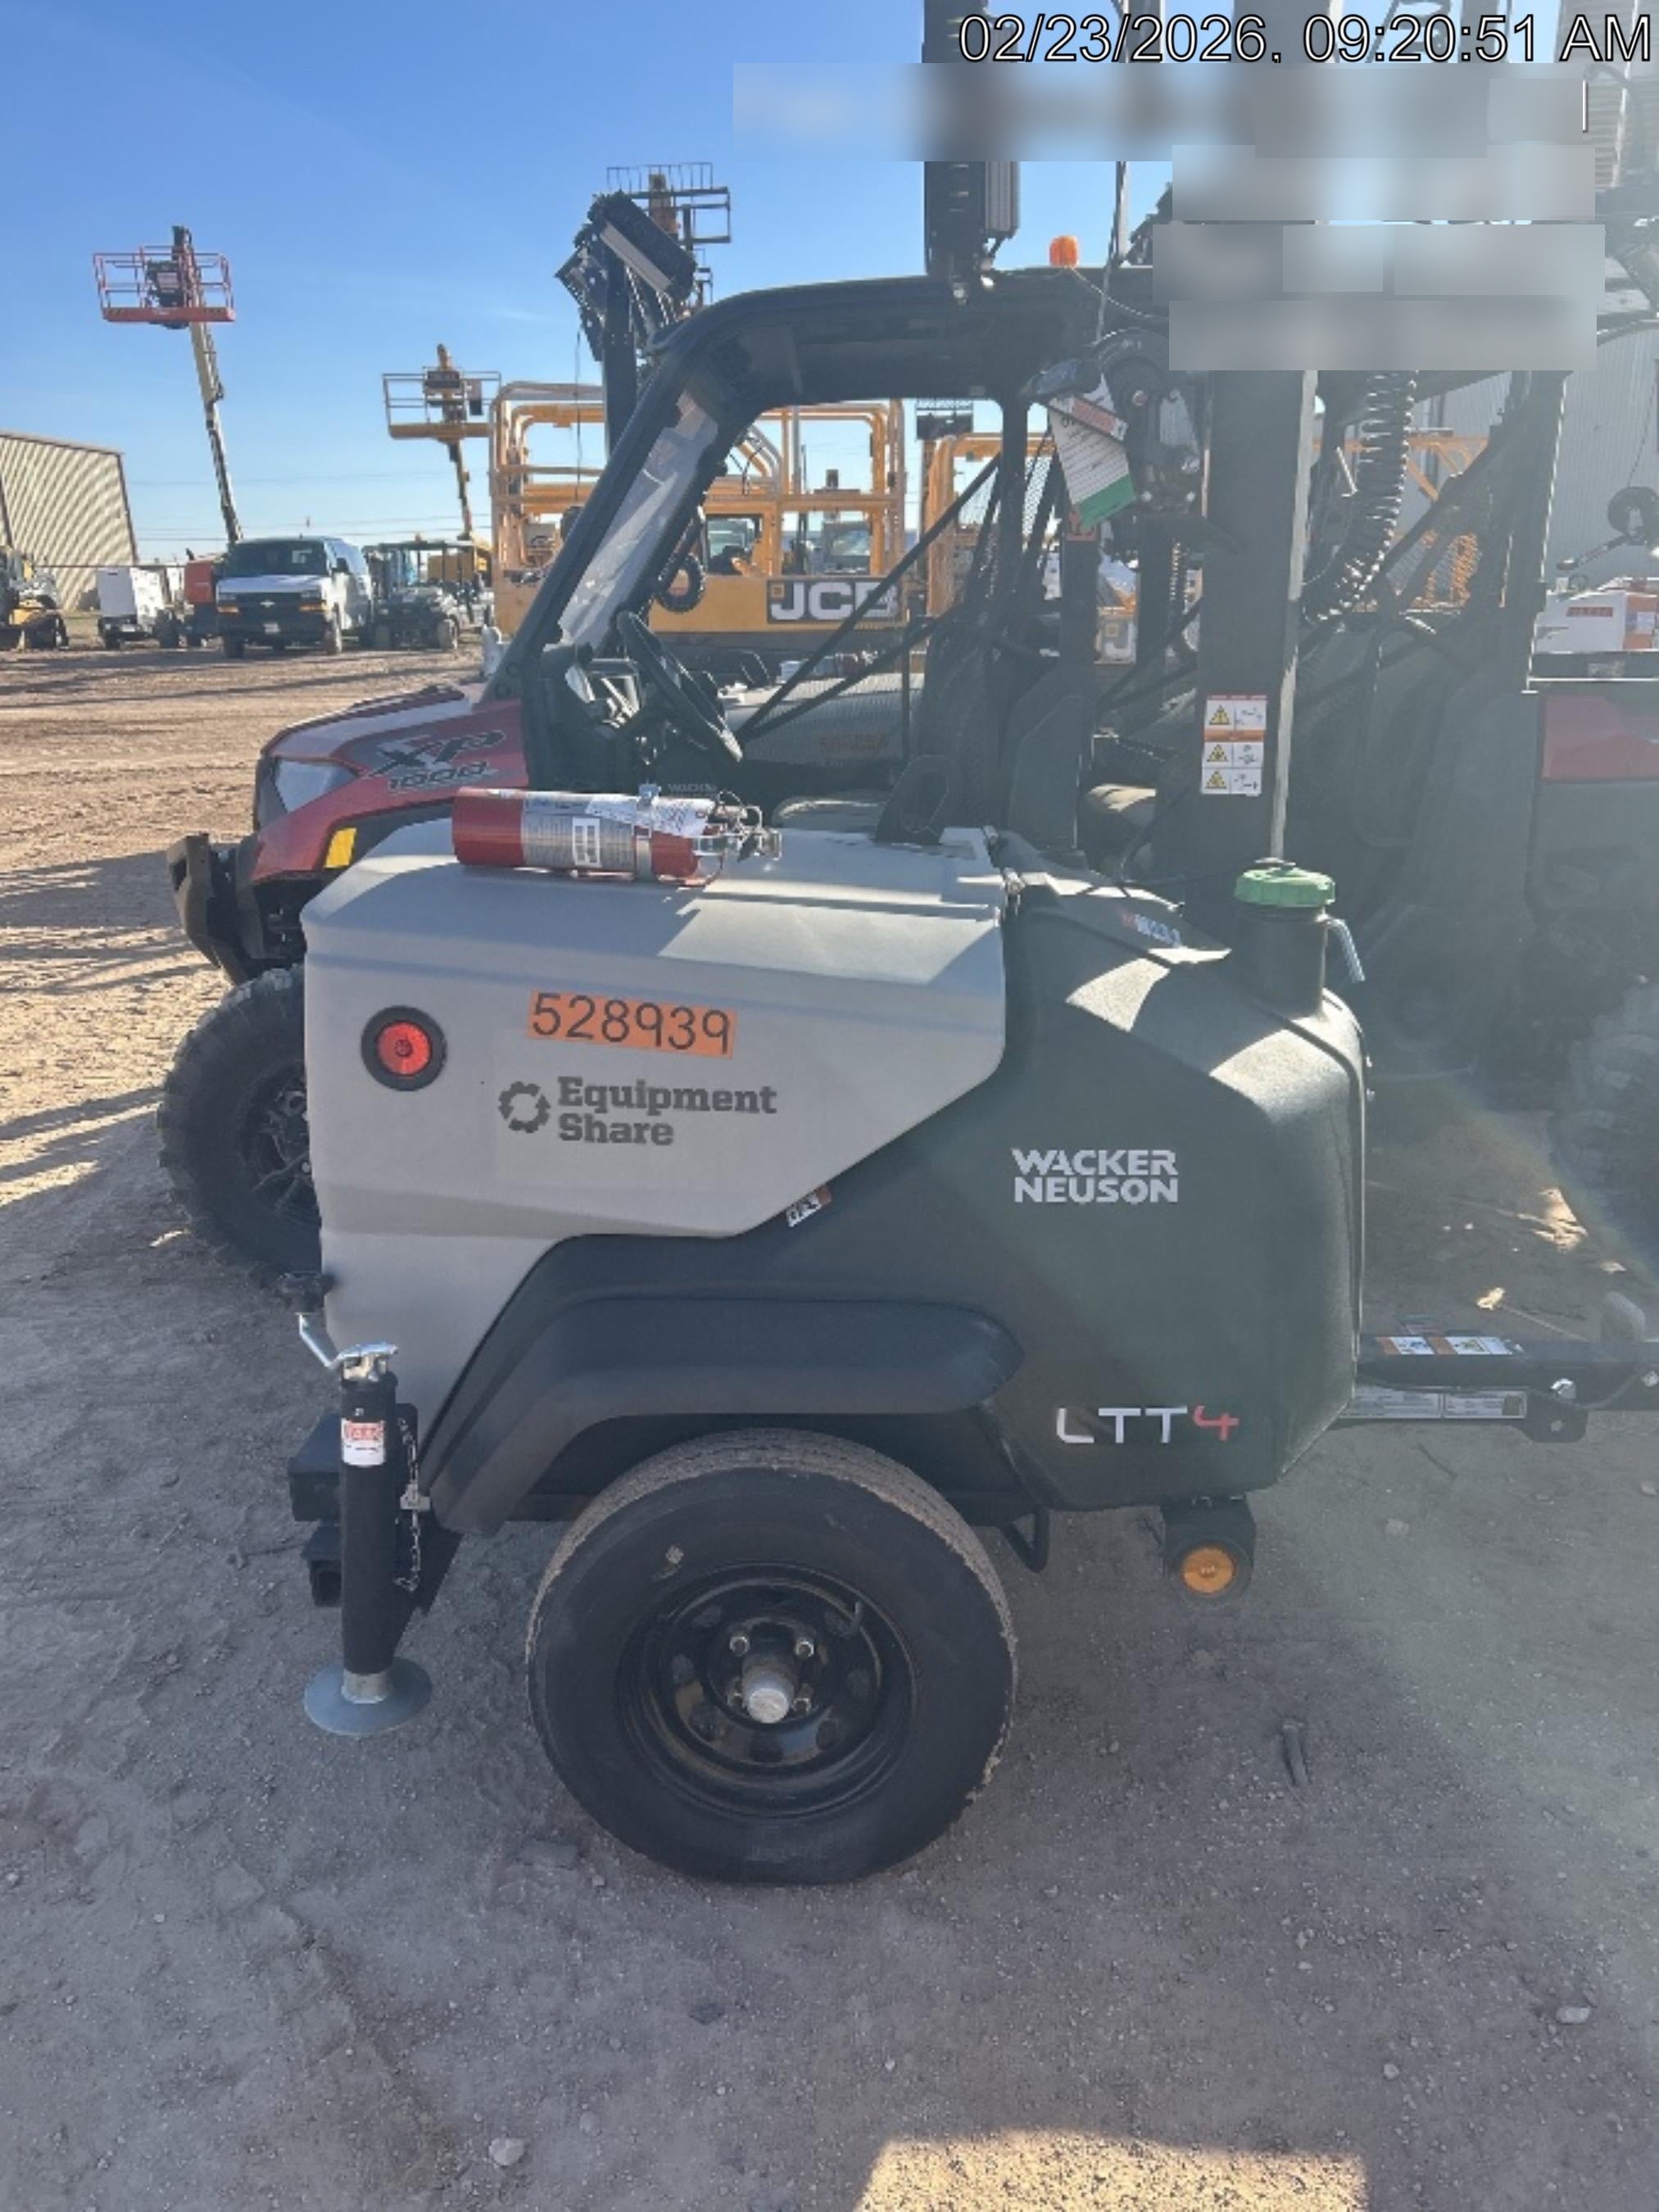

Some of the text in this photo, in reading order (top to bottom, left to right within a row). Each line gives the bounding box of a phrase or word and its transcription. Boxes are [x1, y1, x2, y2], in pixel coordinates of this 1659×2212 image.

[367, 729, 507, 777] XP
[388, 761, 490, 794] 1000
[533, 991, 730, 1055] 528939
[557, 1076, 777, 1117] Equipment
[558, 1113, 675, 1146] Share
[1010, 1149, 1180, 1176] WACKER
[1013, 1176, 1179, 1204] NEUSON
[1055, 1405, 1240, 1444] LTT4
